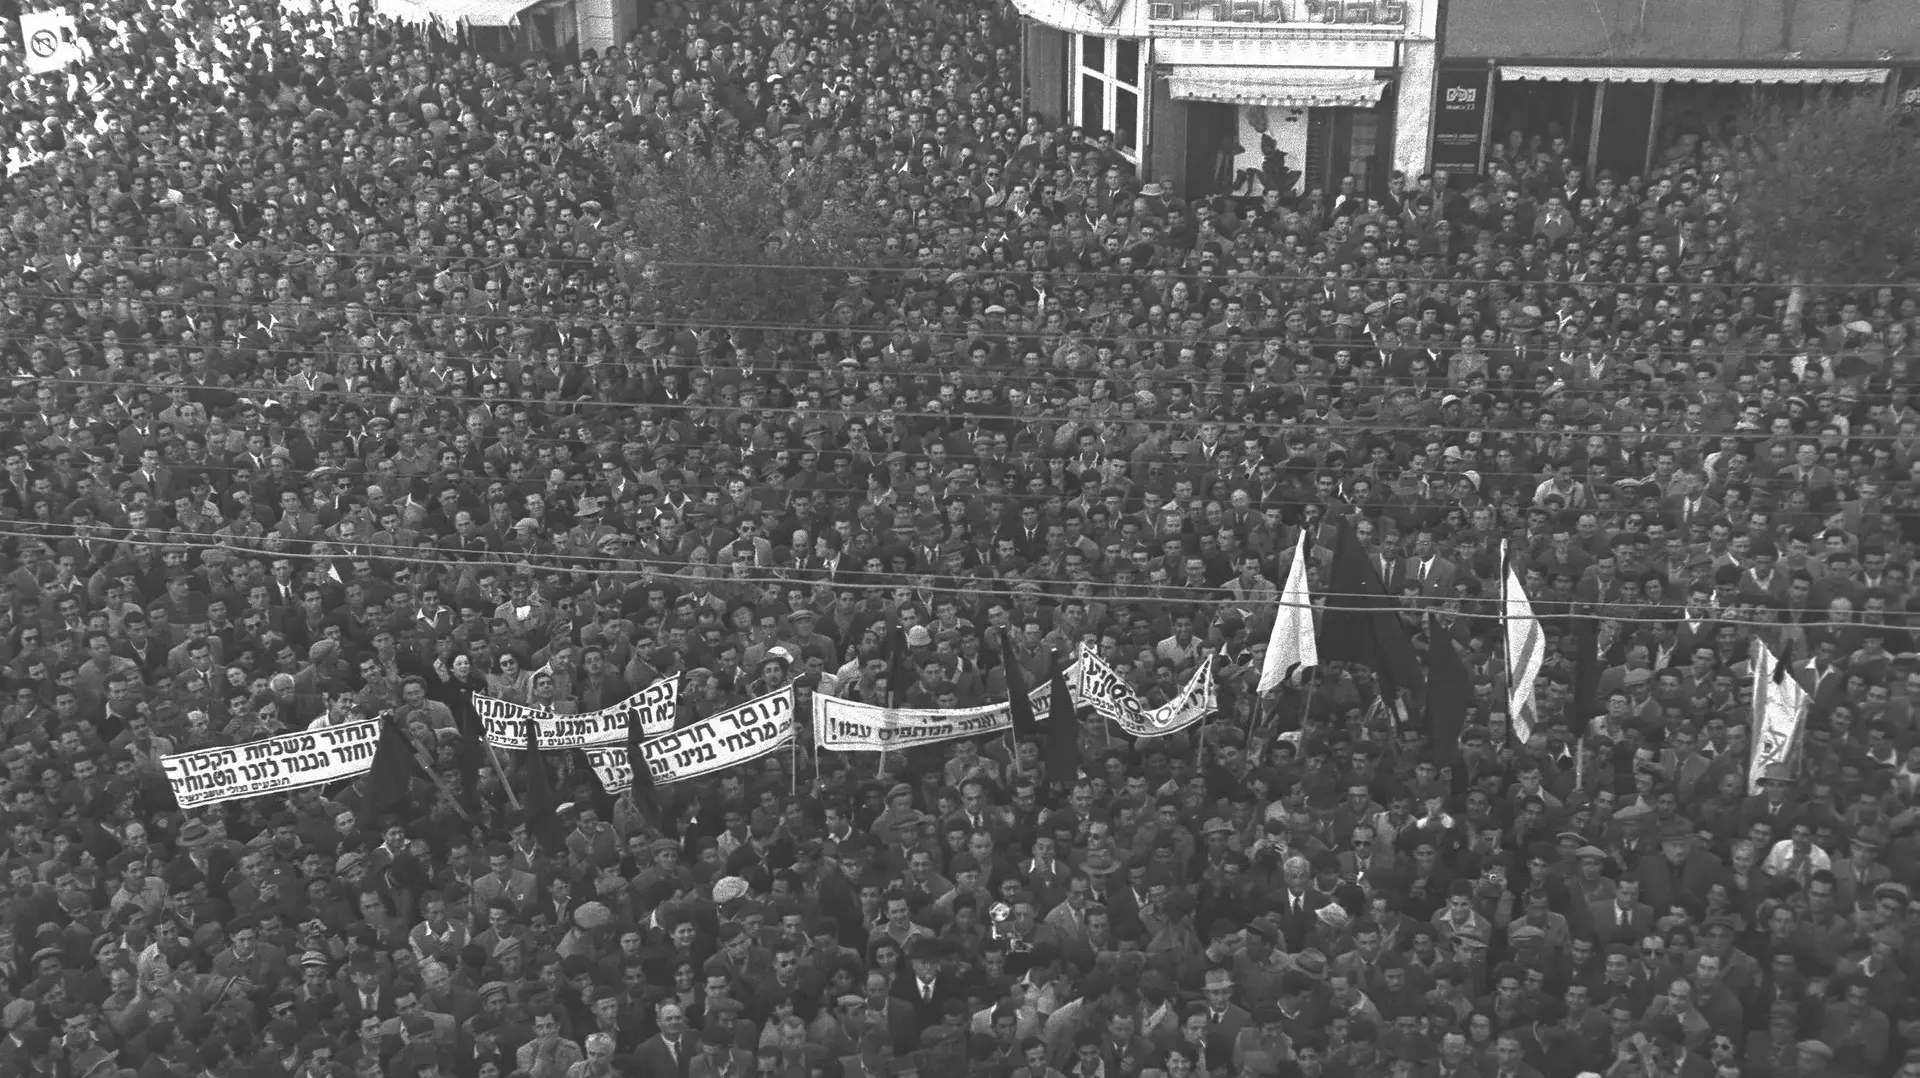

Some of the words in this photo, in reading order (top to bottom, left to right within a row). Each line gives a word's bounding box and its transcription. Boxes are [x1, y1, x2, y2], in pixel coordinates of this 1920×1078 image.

[603, 706, 653, 731] חפת
[656, 700, 676, 722] לא
[720, 697, 790, 729] תוסר
[320, 724, 377, 745] תחזר
[556, 719, 599, 737] המגע
[718, 722, 778, 752] מרצחי
[244, 736, 316, 761] משלחת
[547, 736, 585, 746] תובעים
[643, 722, 716, 759] חרפת
[281, 752, 330, 773] הכבוד
[674, 743, 717, 768] בנינו
[238, 758, 280, 781] לזכר
[251, 777, 290, 790] תובעים
